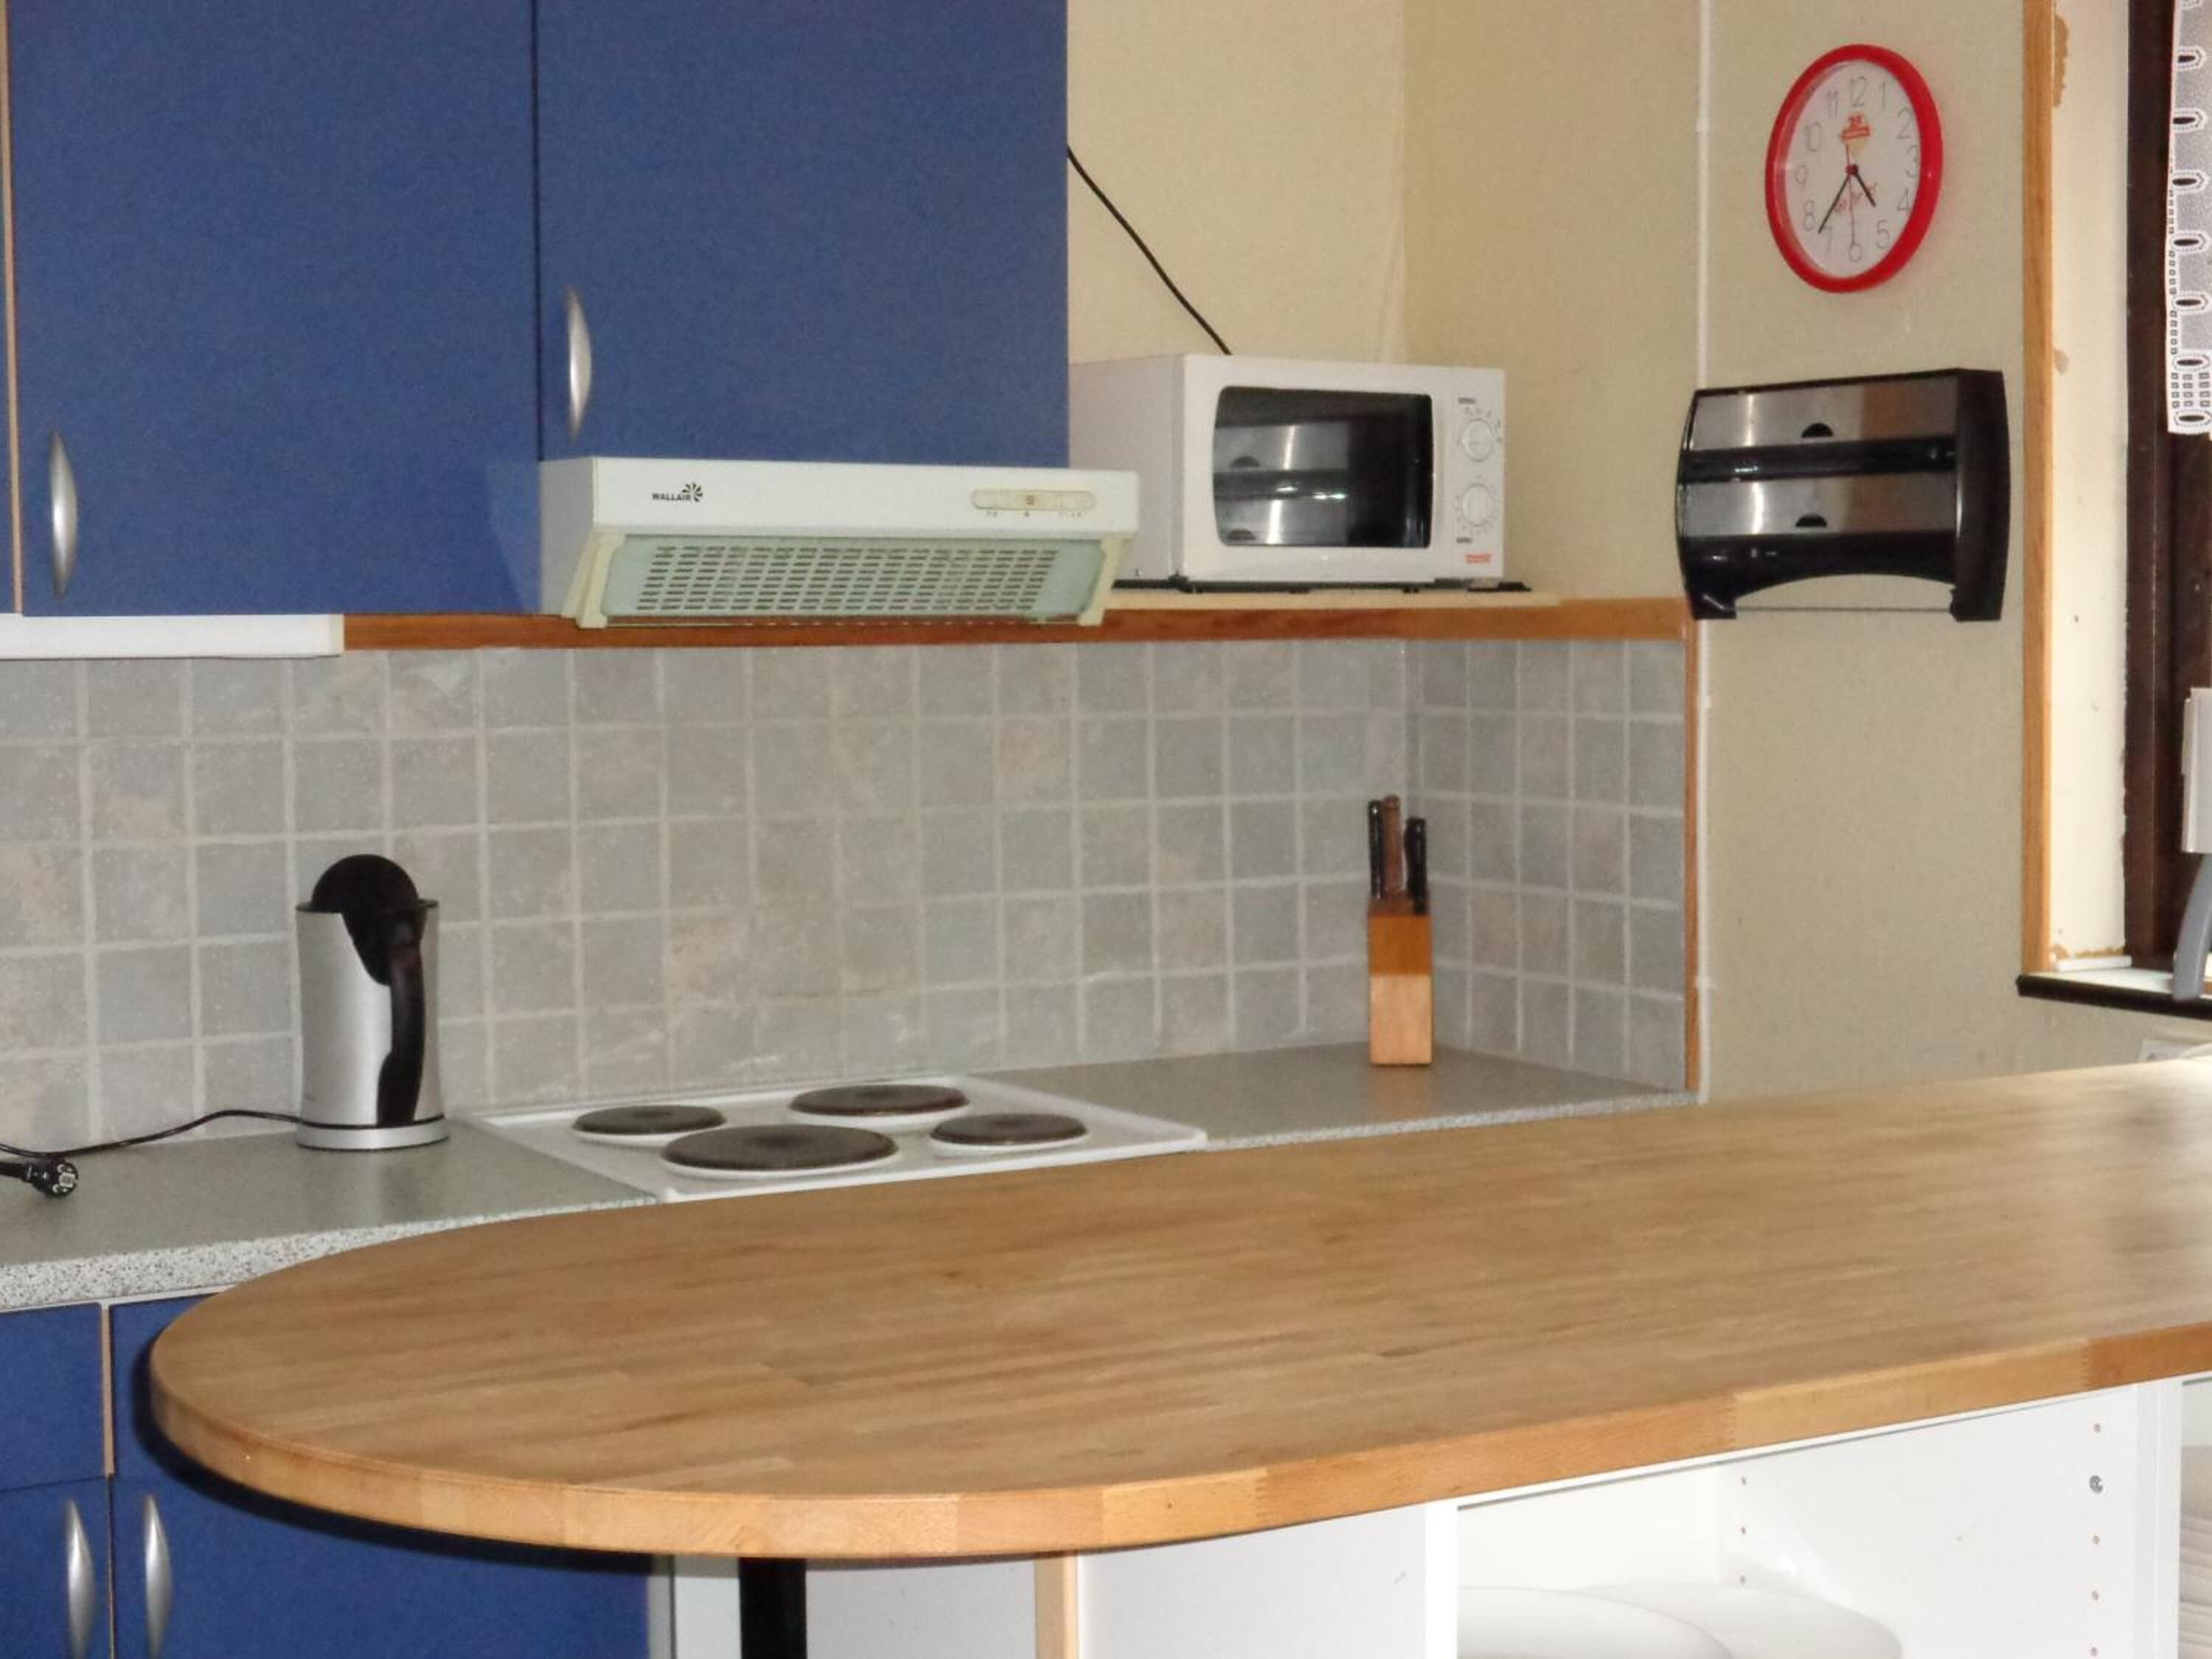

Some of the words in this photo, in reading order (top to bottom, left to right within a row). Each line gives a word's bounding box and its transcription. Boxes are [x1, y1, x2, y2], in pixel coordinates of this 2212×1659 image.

[1849, 75, 1868, 107] 12
[1879, 81, 1888, 110] 1
[1804, 121, 1823, 153] 0
[1897, 106, 1913, 139] 2
[1905, 144, 1920, 179] 3
[1803, 200, 1816, 232] 8
[1896, 189, 1910, 212] 4
[1877, 219, 1891, 249] 5
